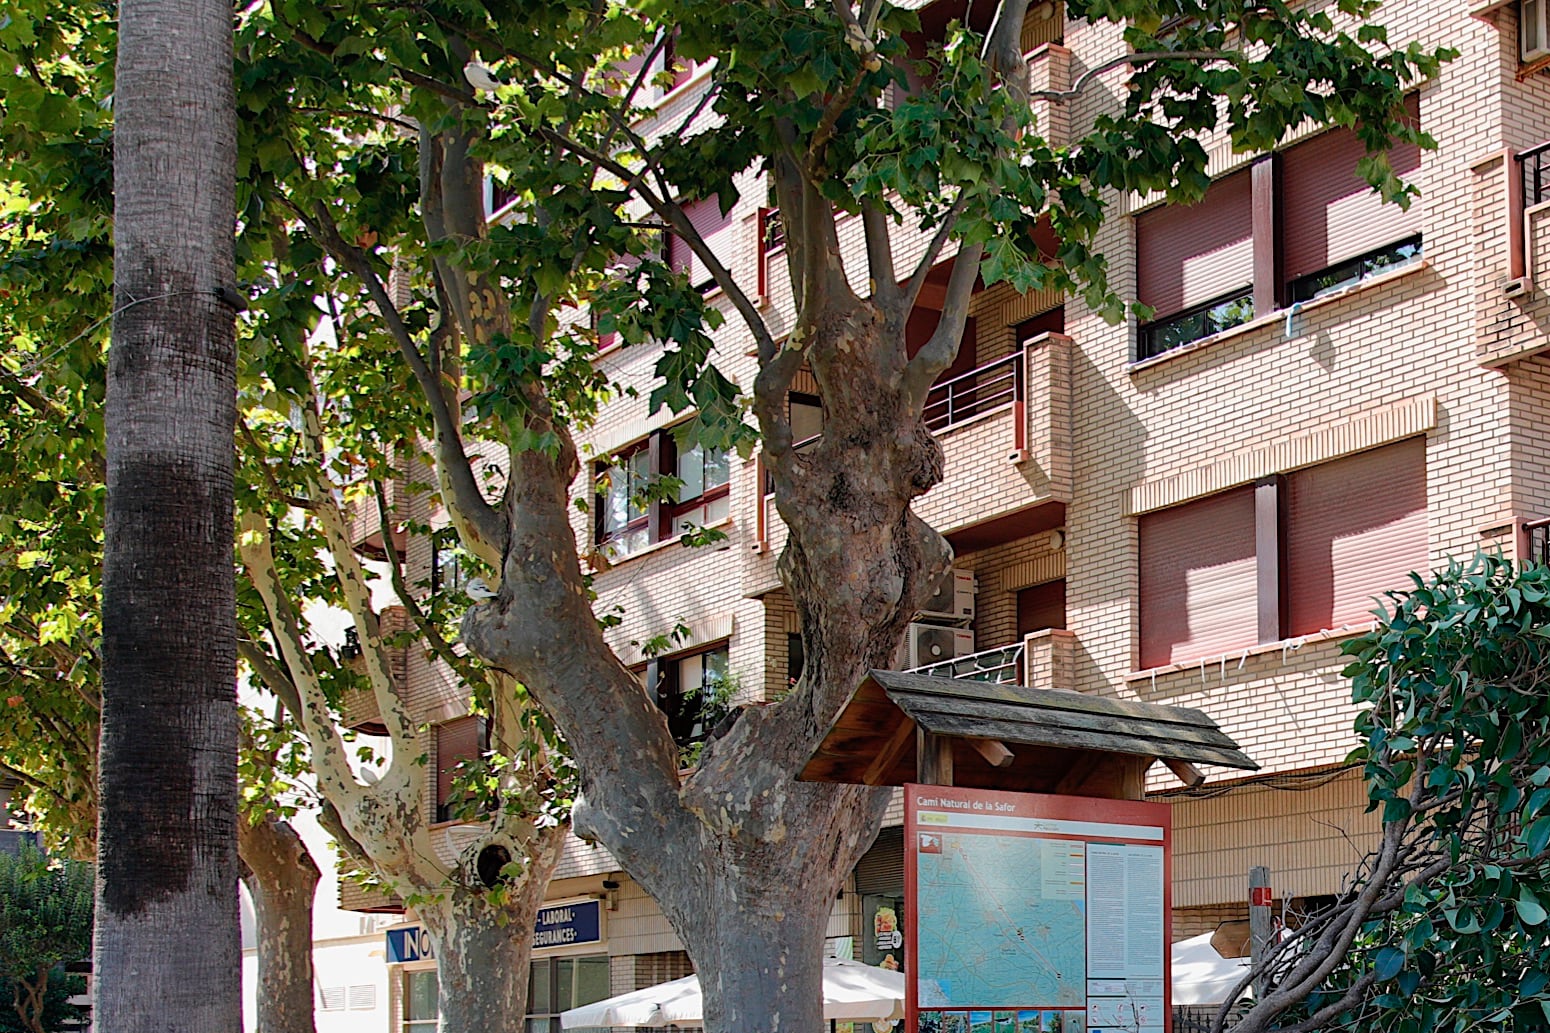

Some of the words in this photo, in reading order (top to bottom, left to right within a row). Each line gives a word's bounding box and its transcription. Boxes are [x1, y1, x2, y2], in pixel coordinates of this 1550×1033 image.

[940, 798, 971, 809] Natural
[972, 801, 984, 810] de
[985, 801, 993, 810] la
[995, 802, 1016, 812] Safor
[404, 929, 435, 959] NO
